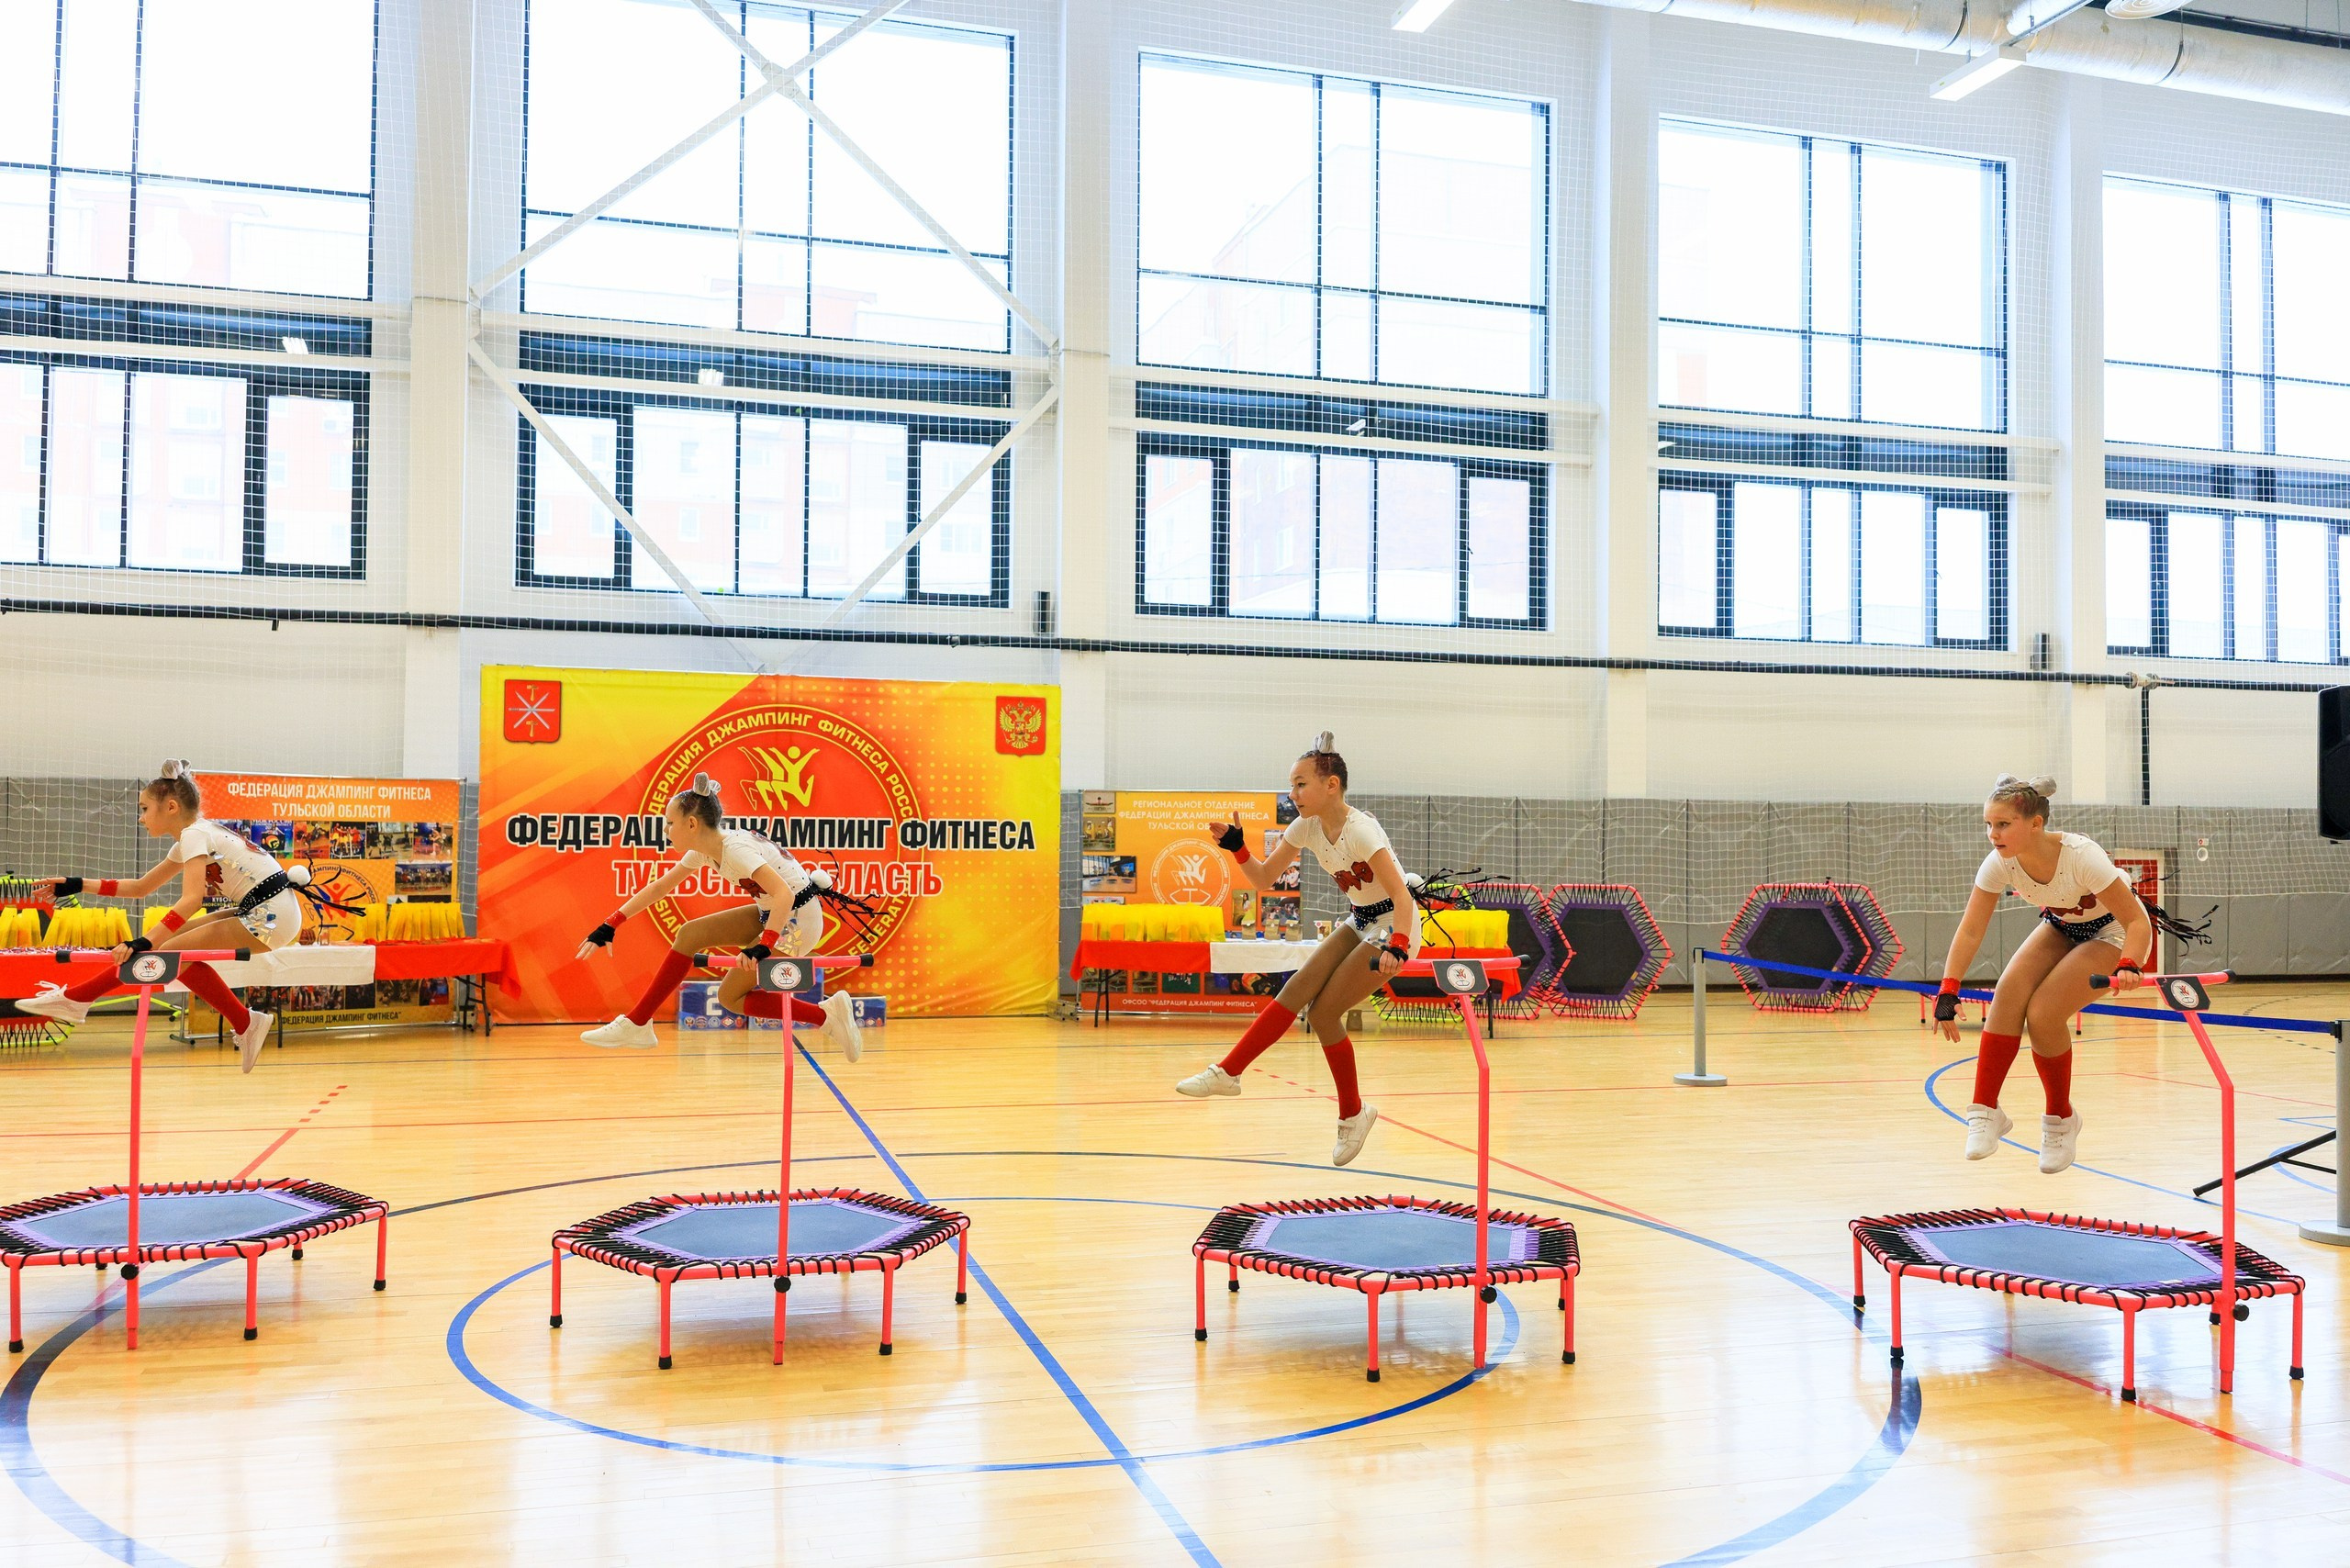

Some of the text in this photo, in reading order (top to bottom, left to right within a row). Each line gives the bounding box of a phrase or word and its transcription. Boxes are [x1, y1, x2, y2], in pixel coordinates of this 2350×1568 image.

[648, 711, 913, 820] ДЕРАЦИЯ ДЖАМПИНГ ФИТНЕСА РОСС
[228, 782, 431, 801] ФЕДЕРАЦИЯ ДЖАМПИНГ ФИТНЕСА
[272, 802, 391, 819] ТУЛЬСКОЙ ОБЛАСТИ
[1204, 801, 1255, 810] ОТДЕЛЕНИЕ
[1118, 811, 1269, 821] ФЕДЕРАЦИИ ДЖАМПИНГ ФТНЕСА
[508, 813, 673, 852] ФЕДЕРАЦ
[899, 818, 1036, 852] ФИТНЕСА
[1148, 821, 1195, 830] ТУЛЬСКОЙ
[848, 892, 907, 956] FEDERAT
[855, 1000, 865, 1017] 3
[325, 1013, 366, 1024] ДЖАМПИНГ
